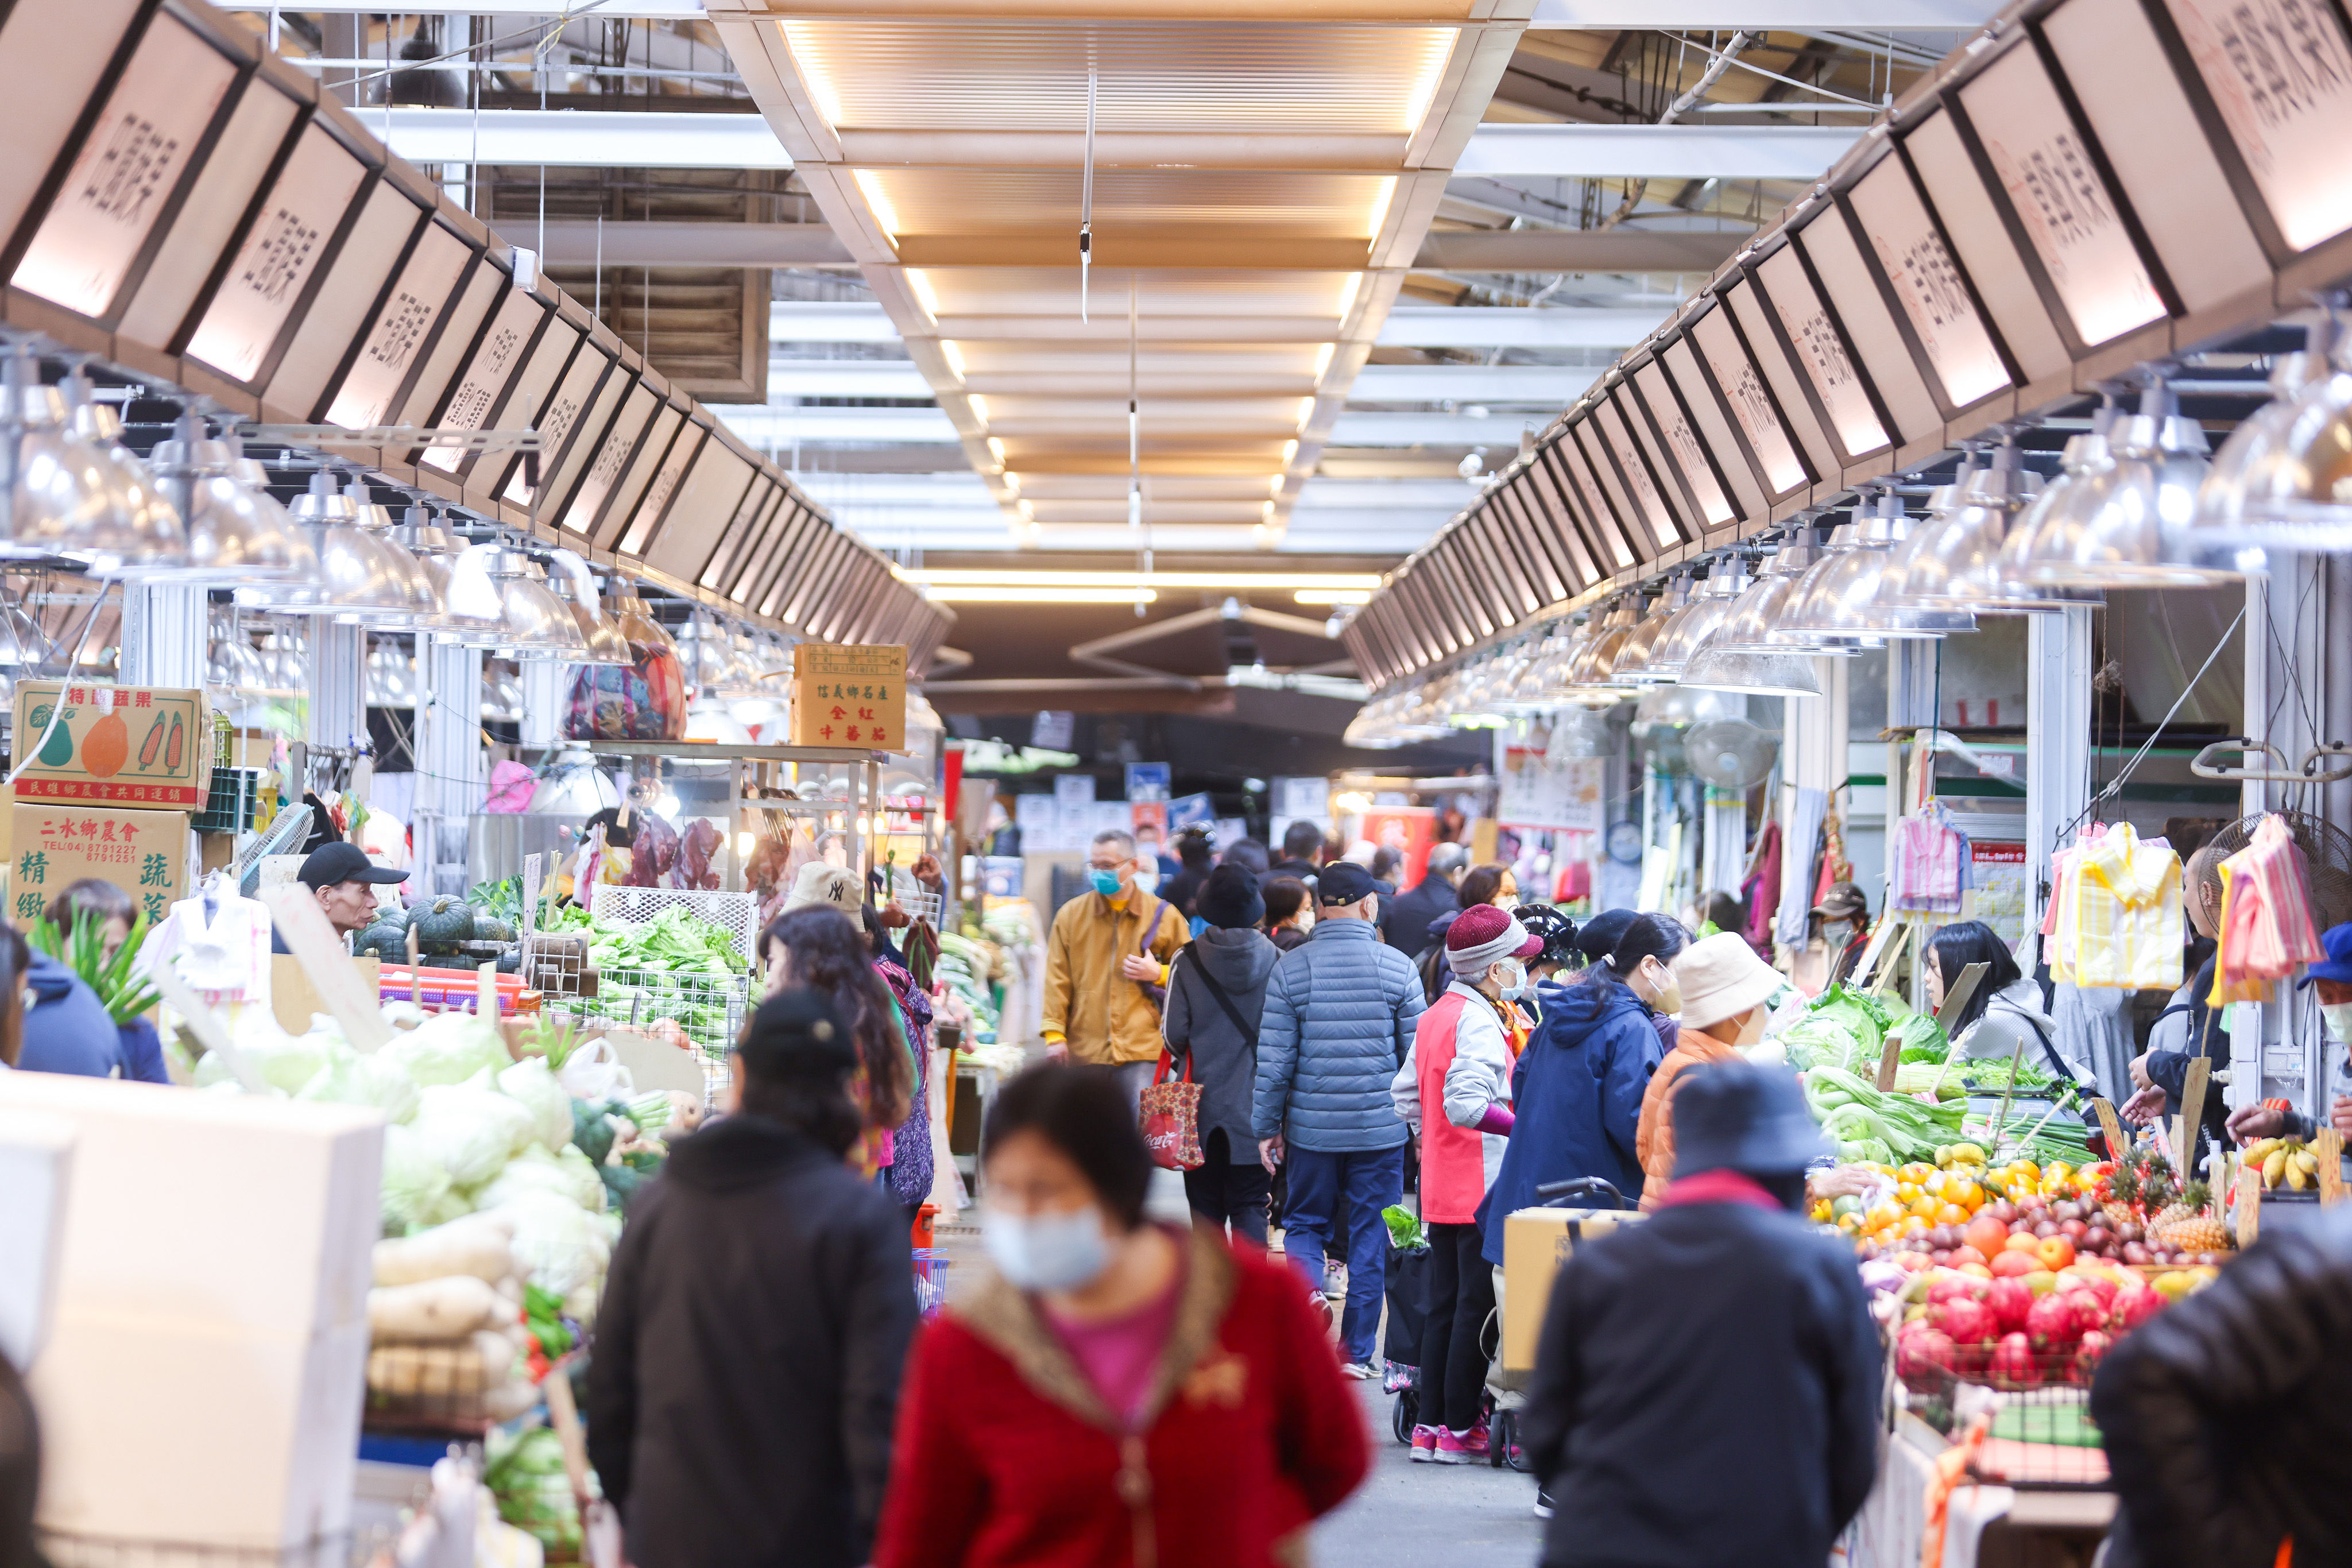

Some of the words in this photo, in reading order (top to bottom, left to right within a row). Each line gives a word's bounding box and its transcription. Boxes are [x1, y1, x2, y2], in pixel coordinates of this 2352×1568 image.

[30, 780, 181, 802] 民雄鄉農會共同運銷
[40, 817, 140, 843] 二水鄉農會
[86, 853, 136, 864] 8791251
[16, 850, 50, 920] 精緻
[140, 853, 172, 925] 蔬菜
